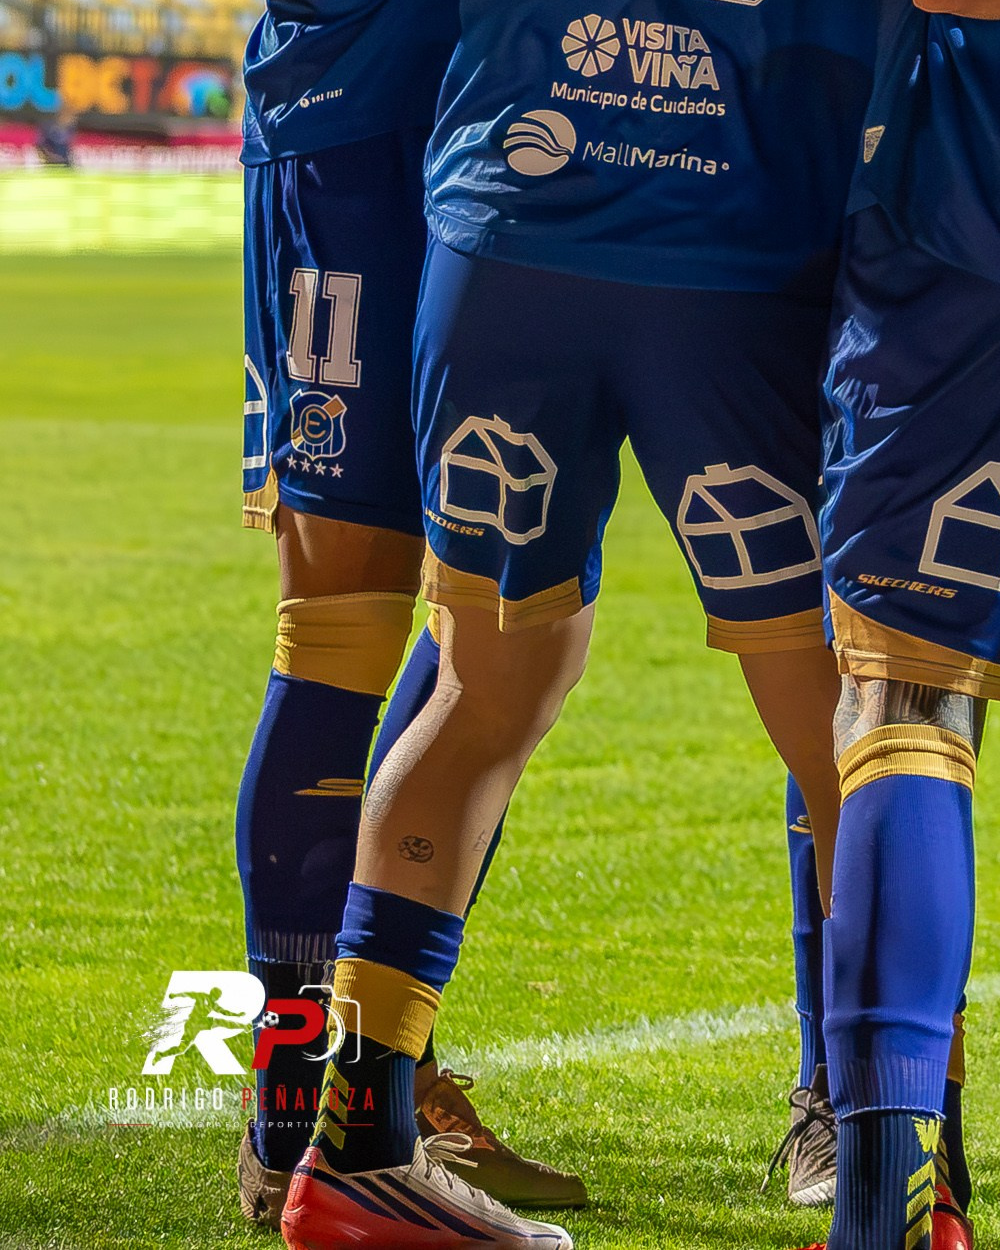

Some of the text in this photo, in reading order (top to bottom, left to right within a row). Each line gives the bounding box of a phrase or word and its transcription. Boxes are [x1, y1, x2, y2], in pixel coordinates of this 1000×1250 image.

[622, 17, 712, 54] VISITA
[628, 48, 721, 91] VIÑA
[551, 82, 727, 117] Municipio de Cuidados
[286, 267, 362, 388] 11
[857, 573, 959, 599] SKECHERS
